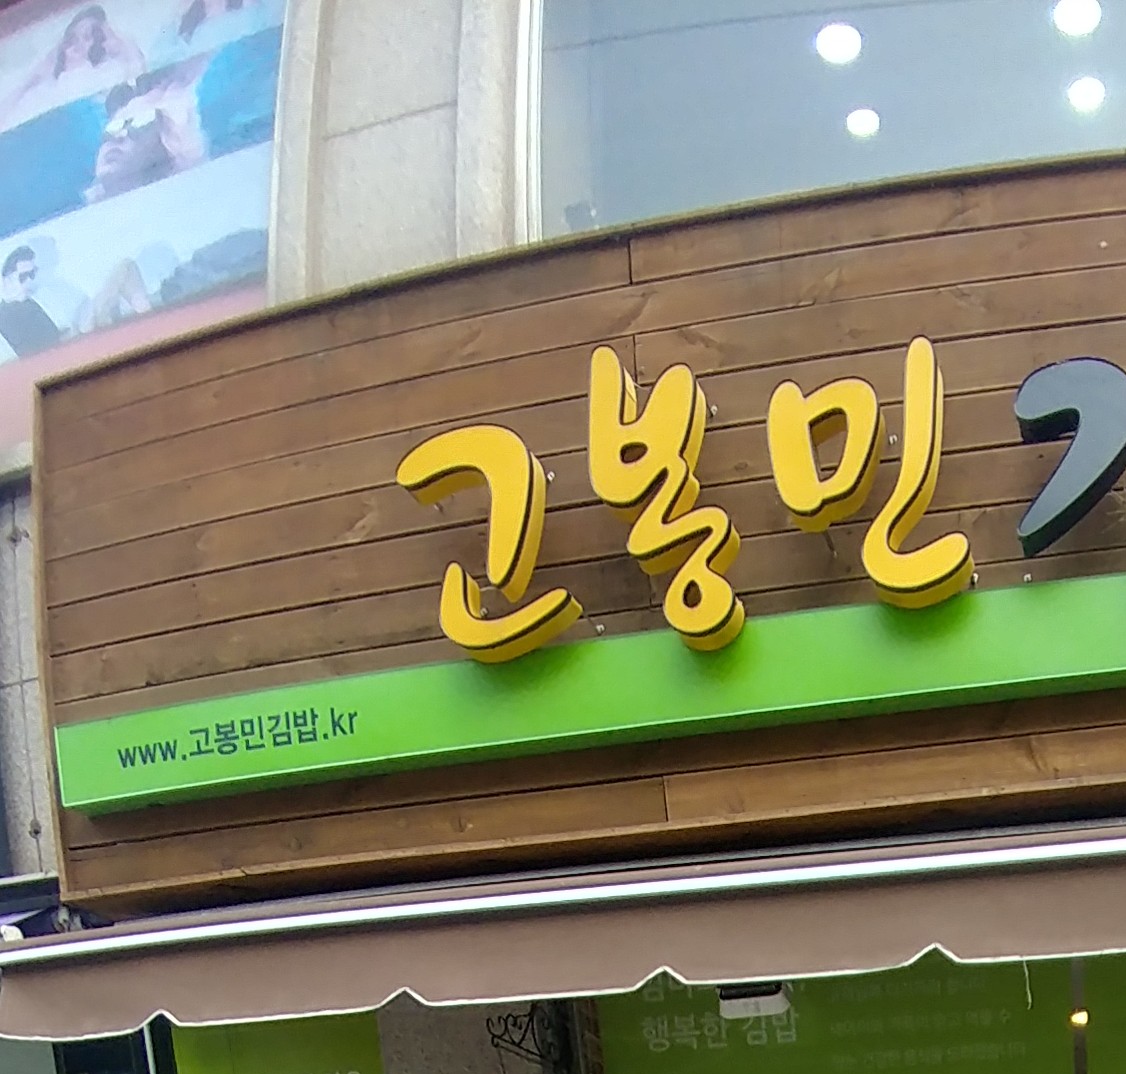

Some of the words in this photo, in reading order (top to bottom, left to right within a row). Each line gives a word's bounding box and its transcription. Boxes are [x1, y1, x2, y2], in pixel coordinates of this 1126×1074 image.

[396, 335, 975, 663] 고봉민
[117, 707, 359, 769] www.고봉민김밥.kr
[643, 1012, 728, 1053] 행복한
